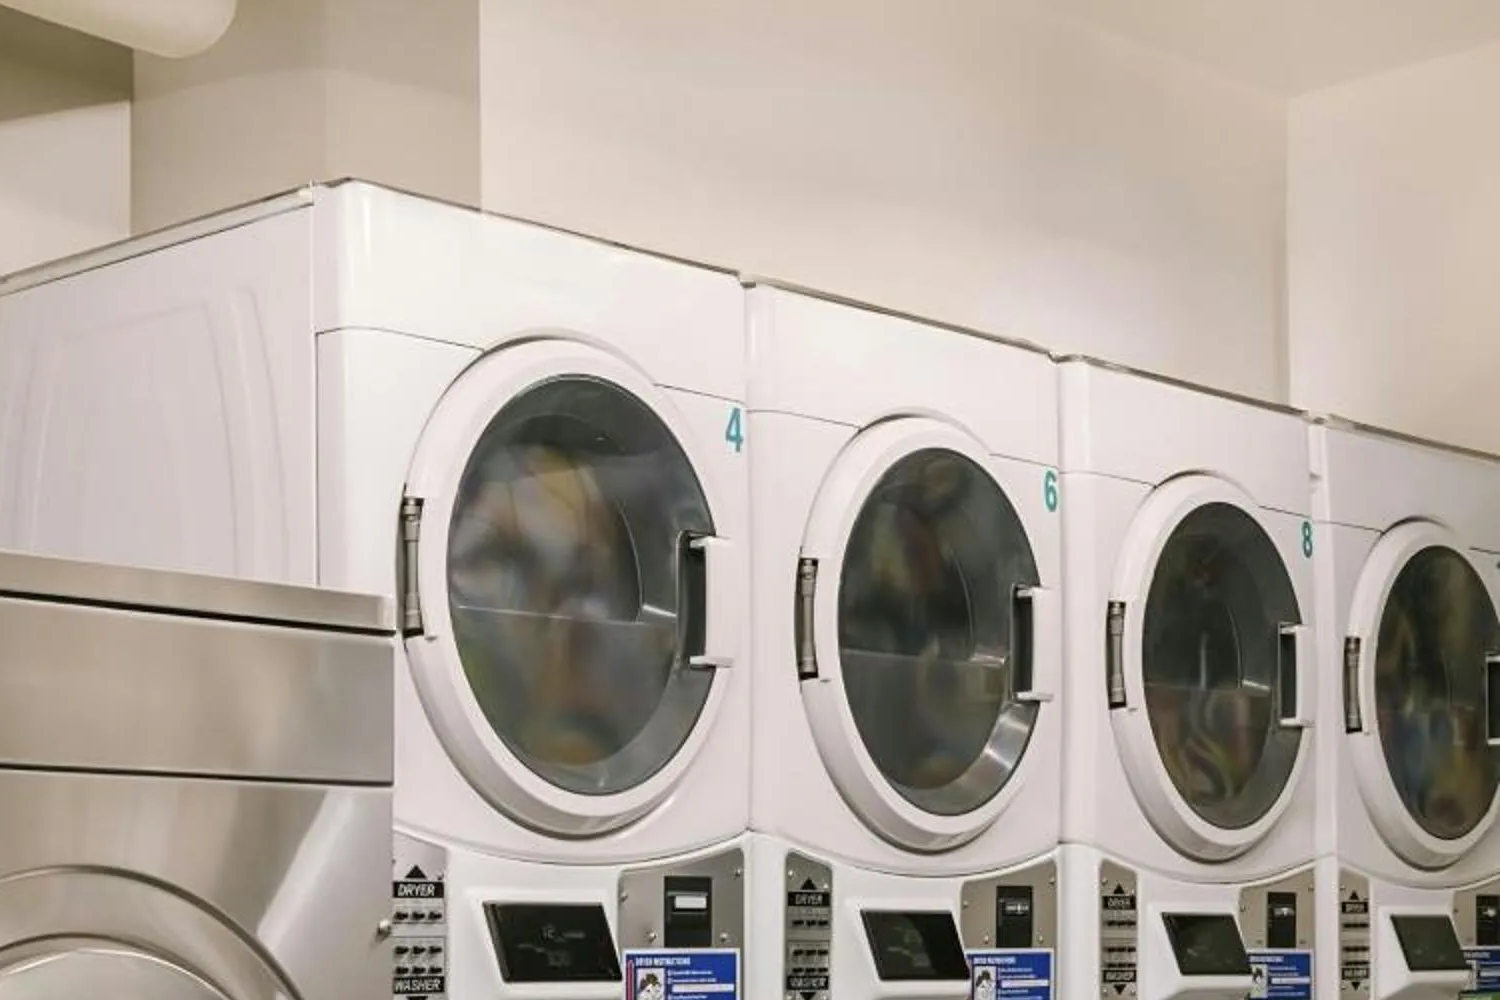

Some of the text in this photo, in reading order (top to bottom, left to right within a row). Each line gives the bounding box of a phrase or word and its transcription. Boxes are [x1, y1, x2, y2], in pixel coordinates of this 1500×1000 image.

[725, 407, 745, 452] 4
[1045, 470, 1057, 512] 6
[1302, 521, 1313, 558] 8
[397, 883, 436, 897] DRYER
[394, 979, 441, 992] WASHER
